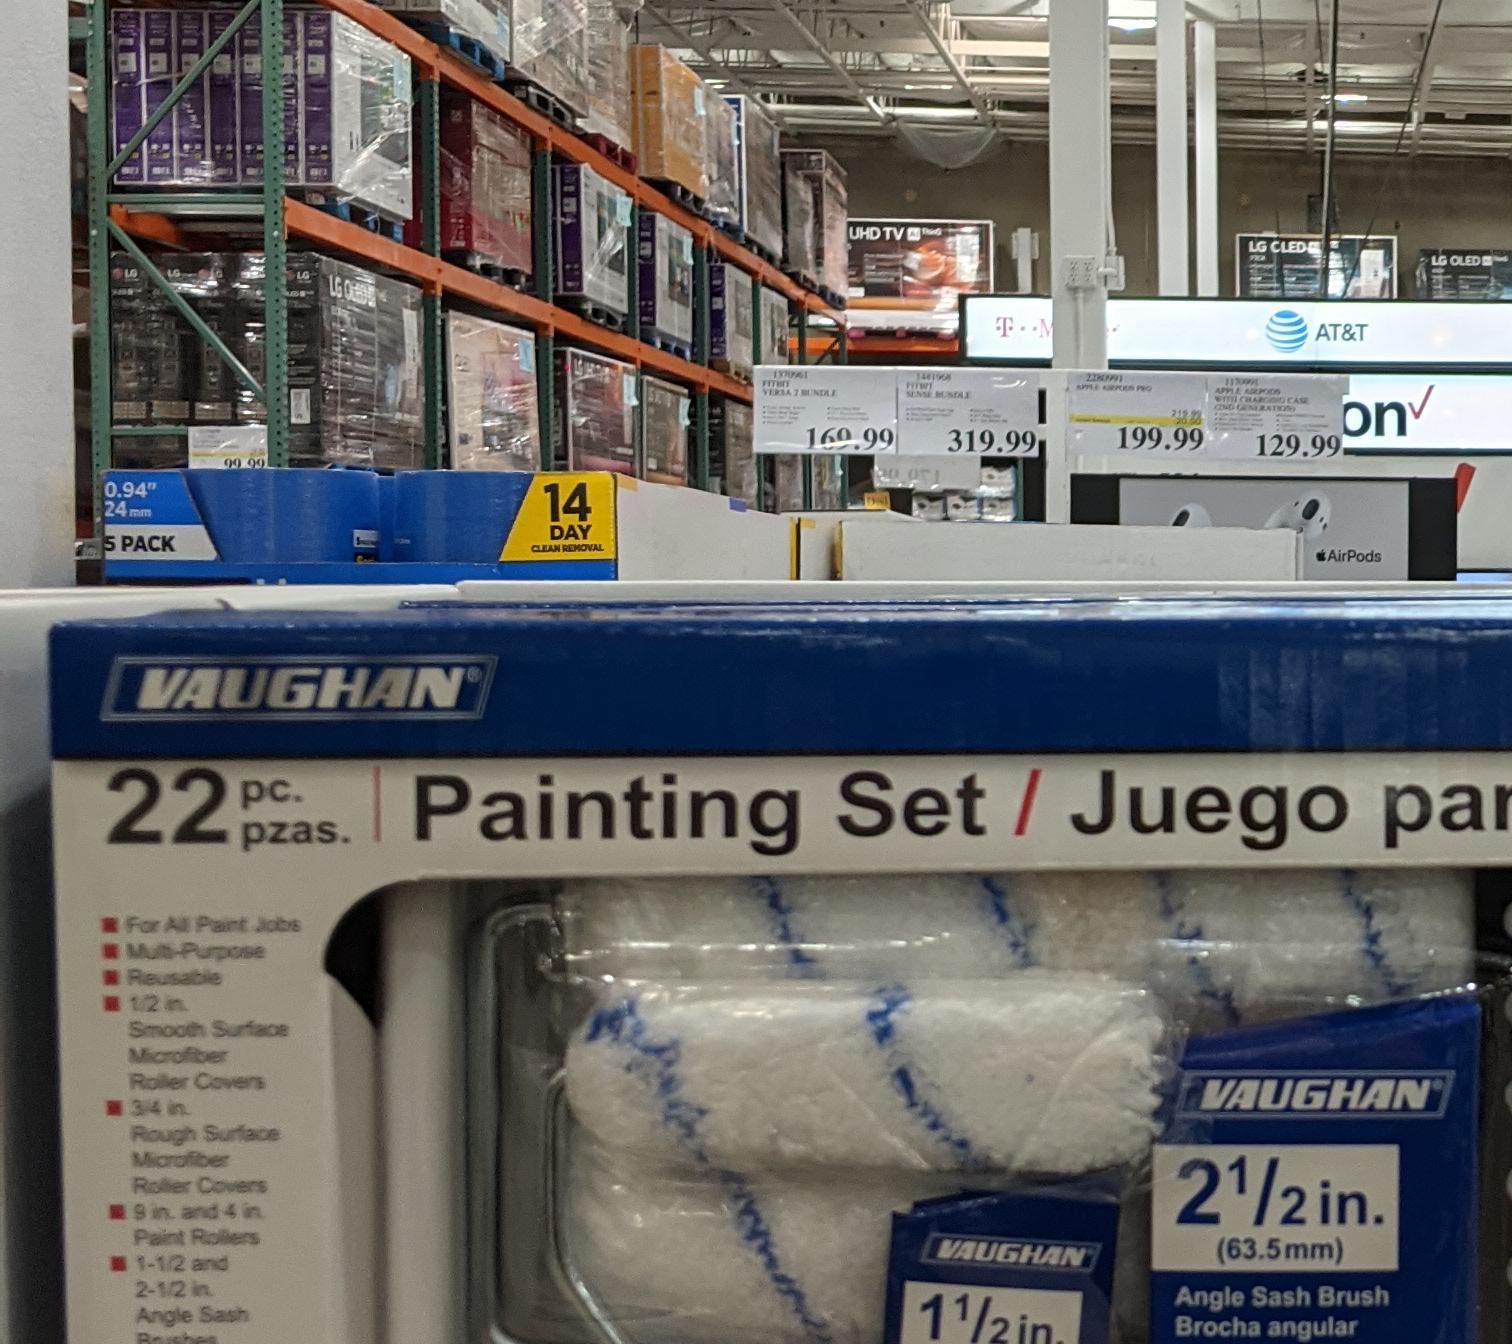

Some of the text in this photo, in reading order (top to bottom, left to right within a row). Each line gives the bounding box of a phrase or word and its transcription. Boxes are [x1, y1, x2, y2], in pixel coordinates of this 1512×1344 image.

[849, 226, 905, 241] UHD TV
[1431, 255, 1447, 266] LG
[1315, 323, 1369, 342] AT&T
[806, 426, 894, 452] 169.99
[947, 428, 1037, 454] 319.99
[1117, 426, 1204, 452] 199.99
[1256, 433, 1341, 458] 129.99
[543, 482, 592, 523] 14
[104, 535, 175, 552] 5 PACK
[550, 523, 591, 541] DAY
[531, 544, 605, 553] CLEAN REMOVAL
[1327, 548, 1382, 564] AirPods
[240, 778, 304, 808] pc.
[104, 768, 229, 846] 22
[414, 772, 802, 856] Painting
[837, 770, 986, 837] Set
[1072, 768, 1350, 849] Juego
[241, 817, 351, 851] pzas.
[1320, 1179, 1385, 1226] in.
[1217, 1237, 1344, 1266] (63.5 mm)
[1175, 1284, 1390, 1312] Angle Sash Brush
[136, 1306, 248, 1327] Angle Sash
[1175, 1315, 1359, 1343] Brocha angular
